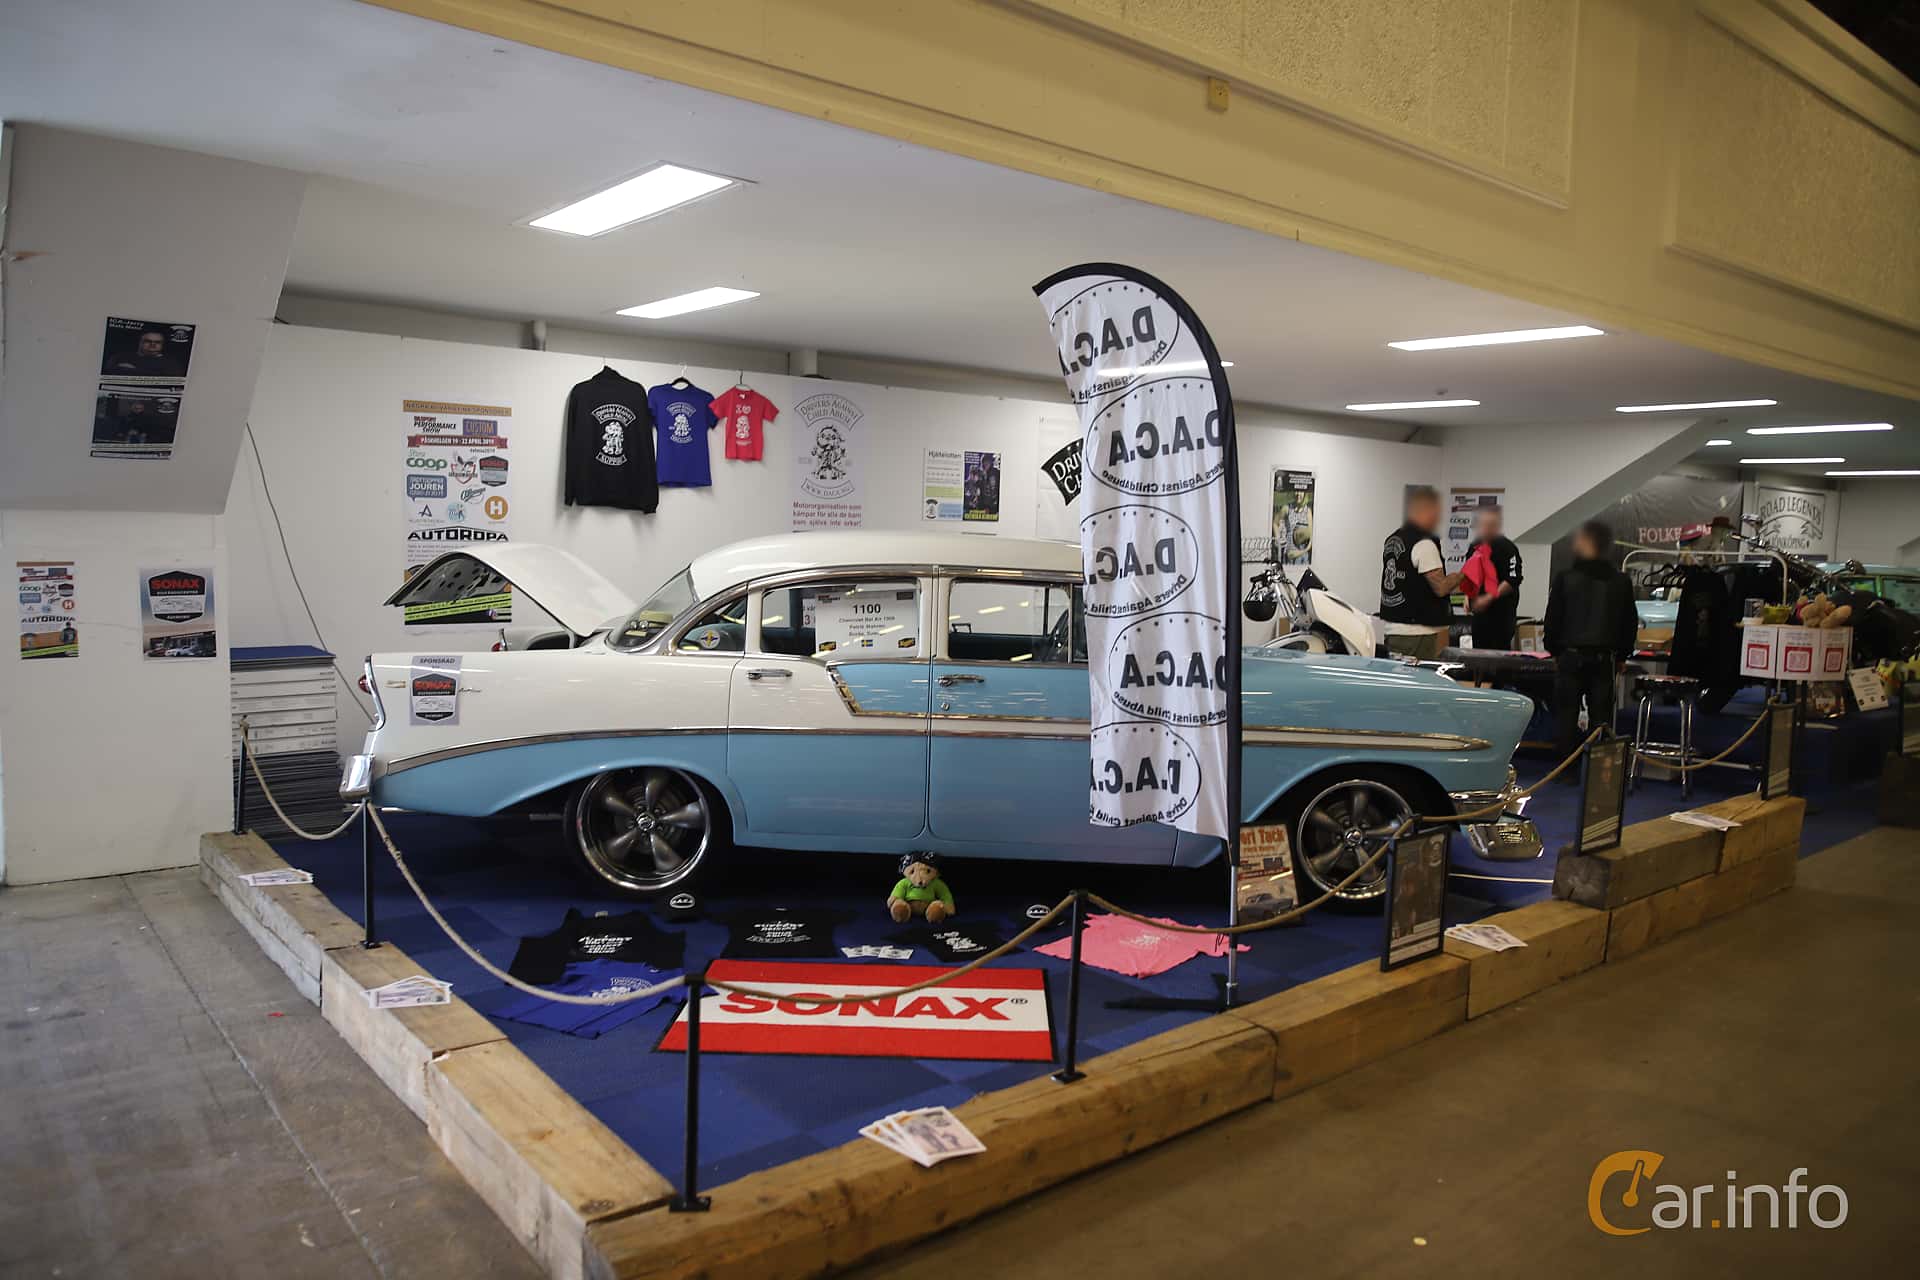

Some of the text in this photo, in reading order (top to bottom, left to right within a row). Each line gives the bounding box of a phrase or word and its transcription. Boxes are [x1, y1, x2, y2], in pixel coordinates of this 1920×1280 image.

[406, 457, 448, 471] coop
[409, 482, 444, 491] JOUREN
[1760, 495, 1821, 525] ROAD LEGENDS
[407, 527, 509, 541] AUTOROPA
[150, 578, 200, 590] SONAX
[853, 603, 882, 614] 1100
[719, 992, 1011, 1021] SONAX
